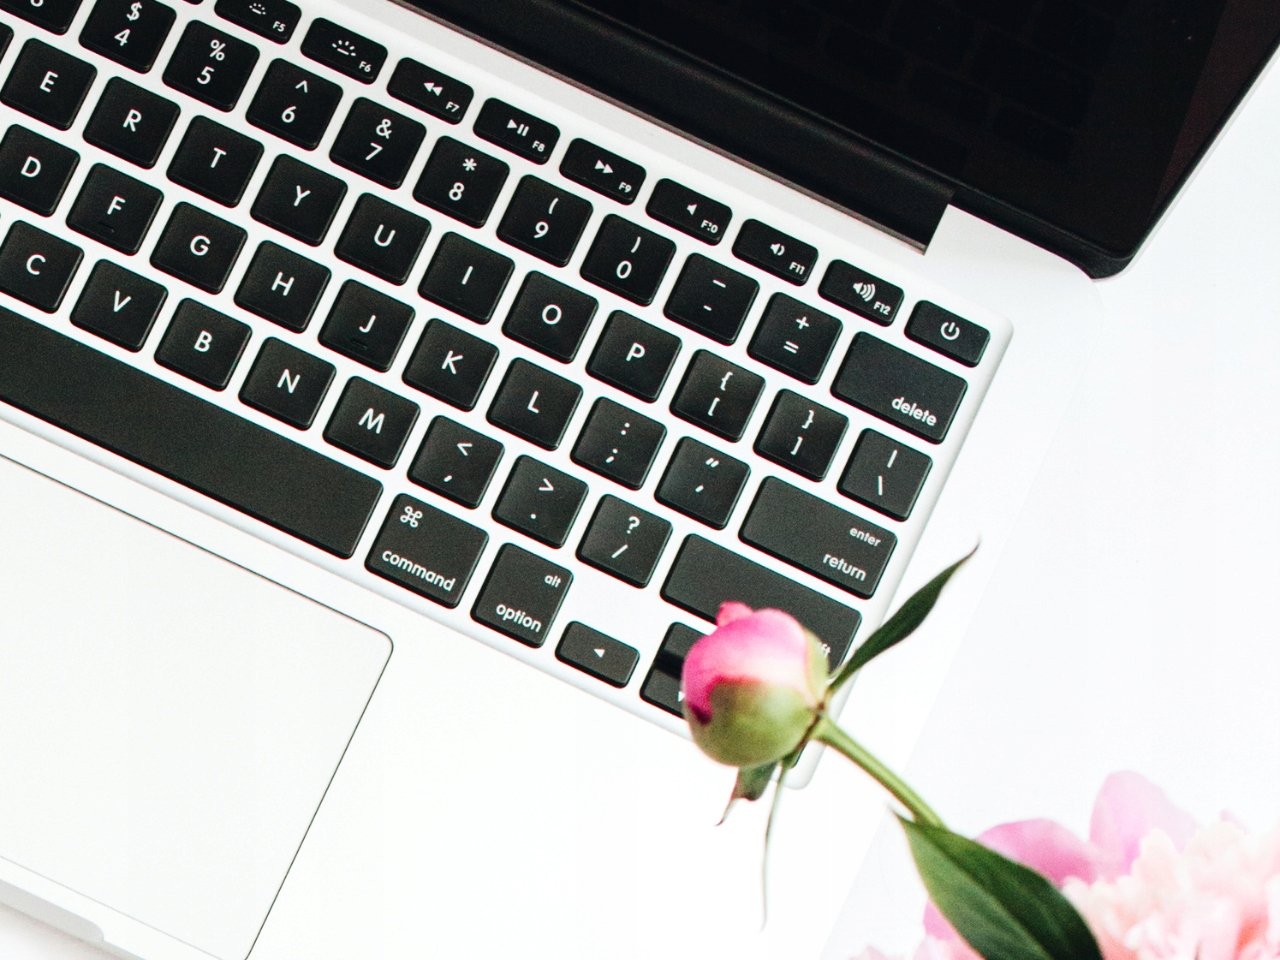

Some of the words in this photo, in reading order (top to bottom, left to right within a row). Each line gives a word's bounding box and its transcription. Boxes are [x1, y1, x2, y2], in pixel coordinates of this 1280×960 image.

[272, 20, 286, 32] F5
[114, 28, 131, 47] 4
[196, 65, 215, 85] 5
[358, 60, 372, 73] F6
[39, 70, 59, 93] E
[281, 105, 297, 123] 6
[445, 101, 460, 113] F7
[122, 108, 142, 132] R
[365, 142, 383, 161] 7
[531, 140, 546, 153] F8
[20, 155, 42, 178] D
[210, 147, 227, 169] T
[293, 185, 311, 207] Y
[448, 182, 465, 201] 8
[618, 181, 632, 193] F9
[106, 195, 126, 215] F
[373, 224, 396, 247] U
[533, 221, 549, 239] 9
[189, 235, 211, 256] G
[26, 254, 46, 276] C
[616, 260, 632, 279] 0
[789, 261, 806, 275] F11
[271, 271, 295, 297] H
[113, 290, 132, 313] V
[873, 301, 891, 316] F12
[358, 314, 377, 333] J
[541, 304, 562, 325] O
[193, 330, 213, 353] B
[625, 342, 646, 362] P
[441, 350, 464, 375] K
[276, 368, 301, 394] N
[527, 390, 540, 414] L
[891, 396, 937, 427] delete
[358, 407, 385, 434] M
[849, 527, 882, 547] enter
[381, 550, 456, 592] command
[822, 553, 867, 582] return
[544, 574, 562, 588] alt
[495, 603, 542, 633] option
